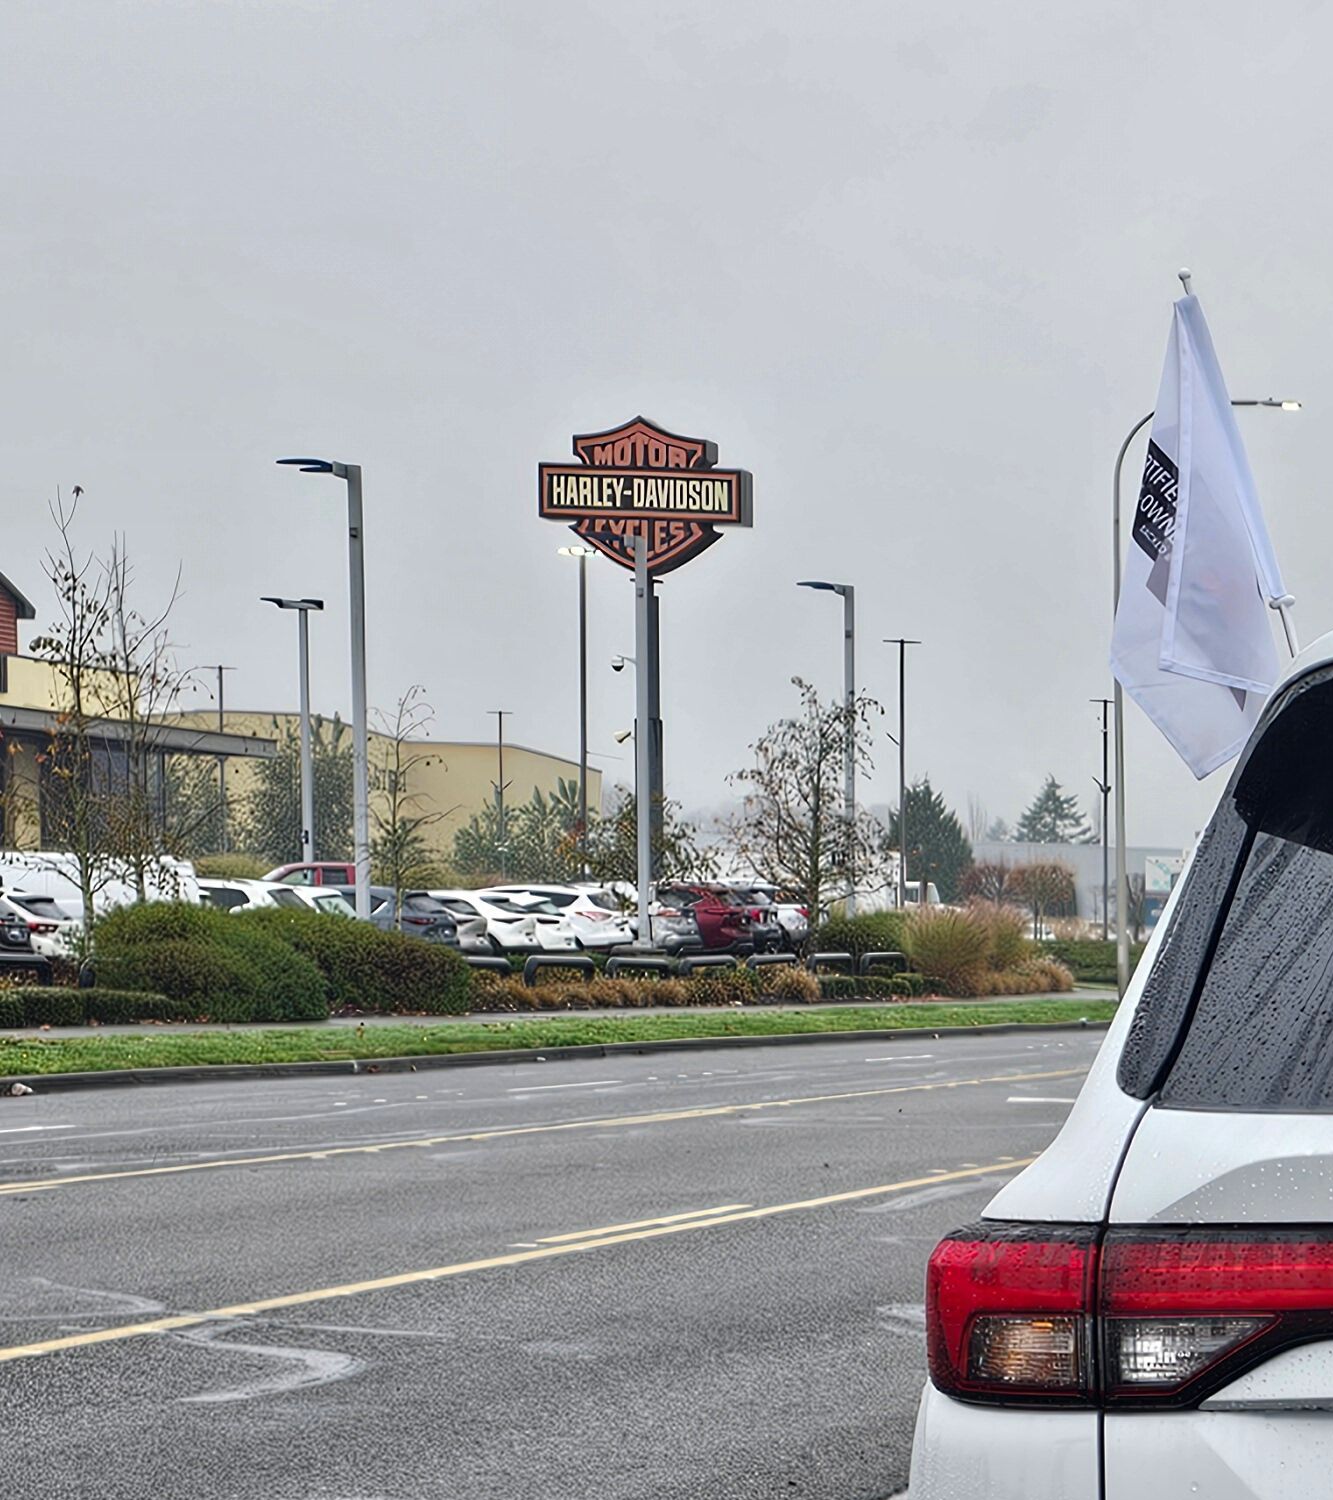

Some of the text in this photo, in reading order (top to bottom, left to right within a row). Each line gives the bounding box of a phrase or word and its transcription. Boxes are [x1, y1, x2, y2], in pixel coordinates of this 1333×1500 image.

[594, 431, 688, 468] MOTOR
[552, 474, 729, 511] HARLEY-DAVIDSON
[1145, 453, 1178, 507] TIFIE
